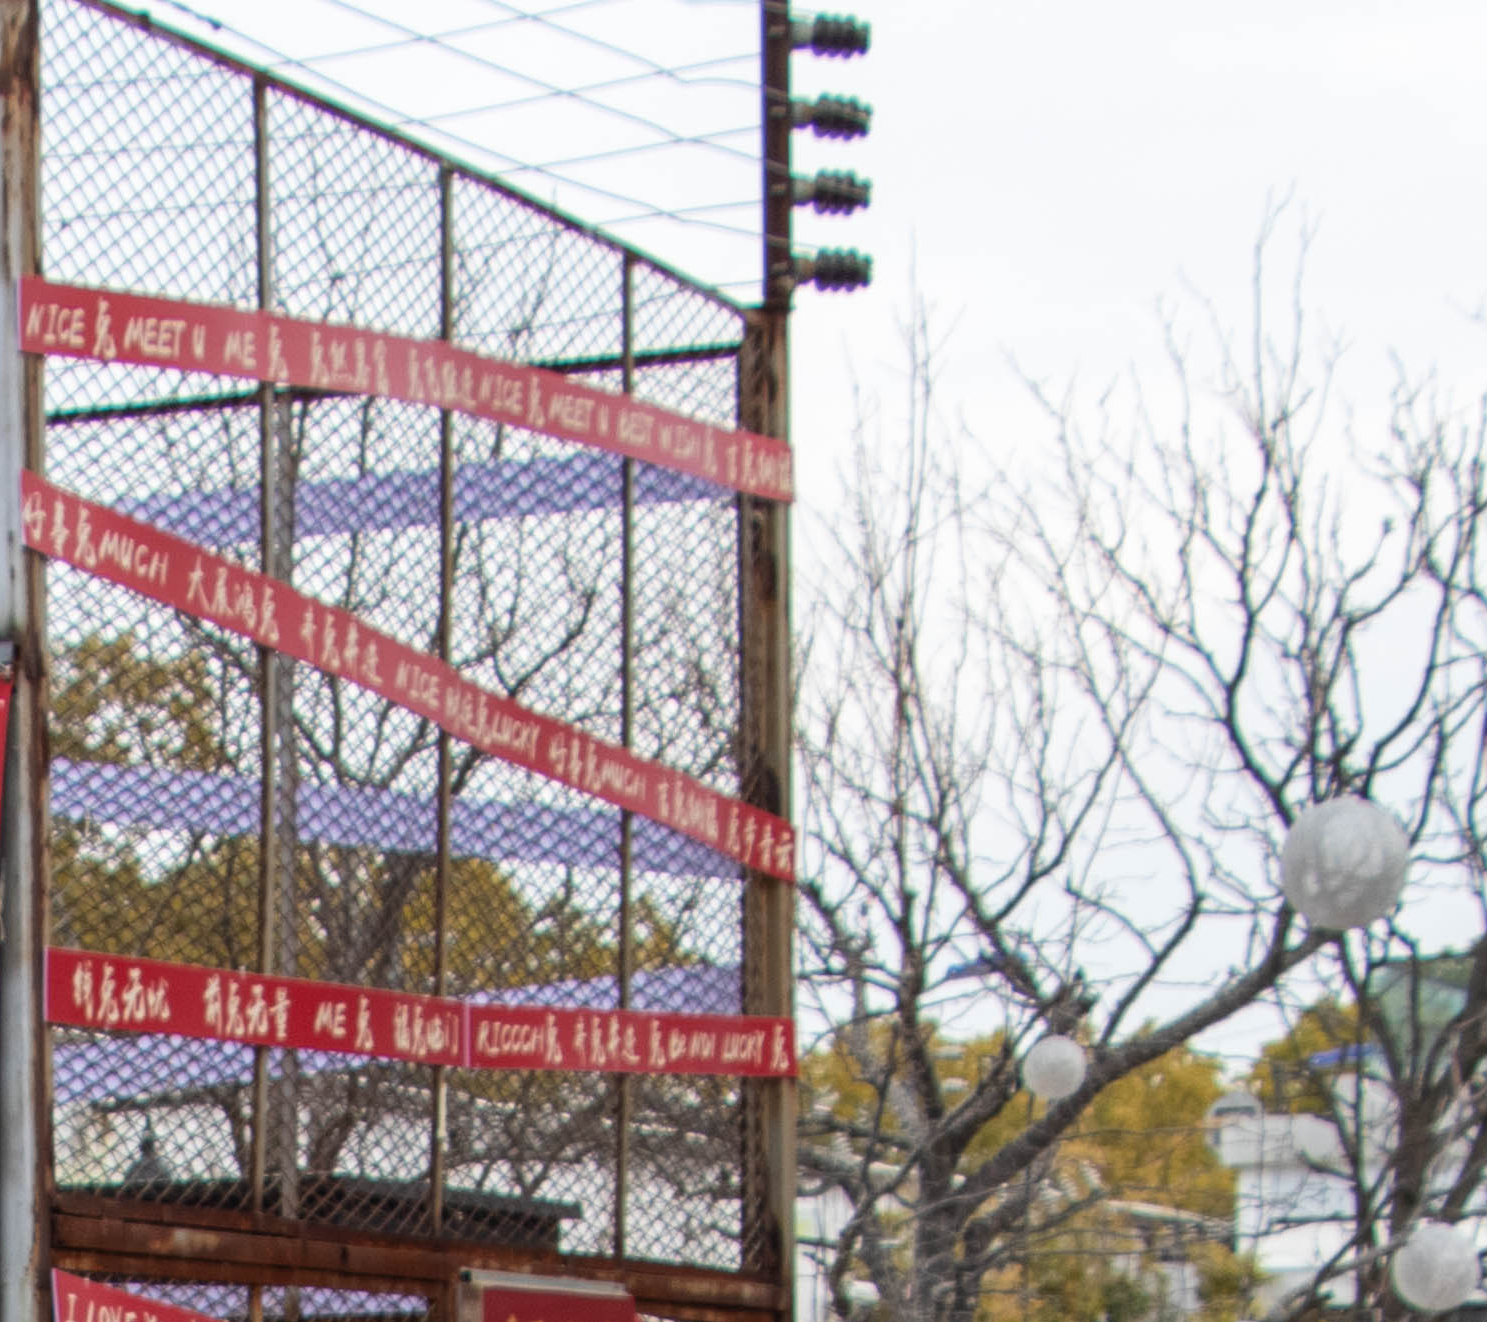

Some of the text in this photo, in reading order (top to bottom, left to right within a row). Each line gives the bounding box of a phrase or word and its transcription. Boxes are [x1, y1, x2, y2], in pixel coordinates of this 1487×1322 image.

[26, 302, 86, 347] NICE
[93, 297, 117, 359] 兔
[123, 317, 186, 358] MEET
[192, 325, 206, 359] U
[225, 330, 257, 369] ME
[99, 528, 169, 586] MUCH
[313, 1000, 347, 1039] ME
